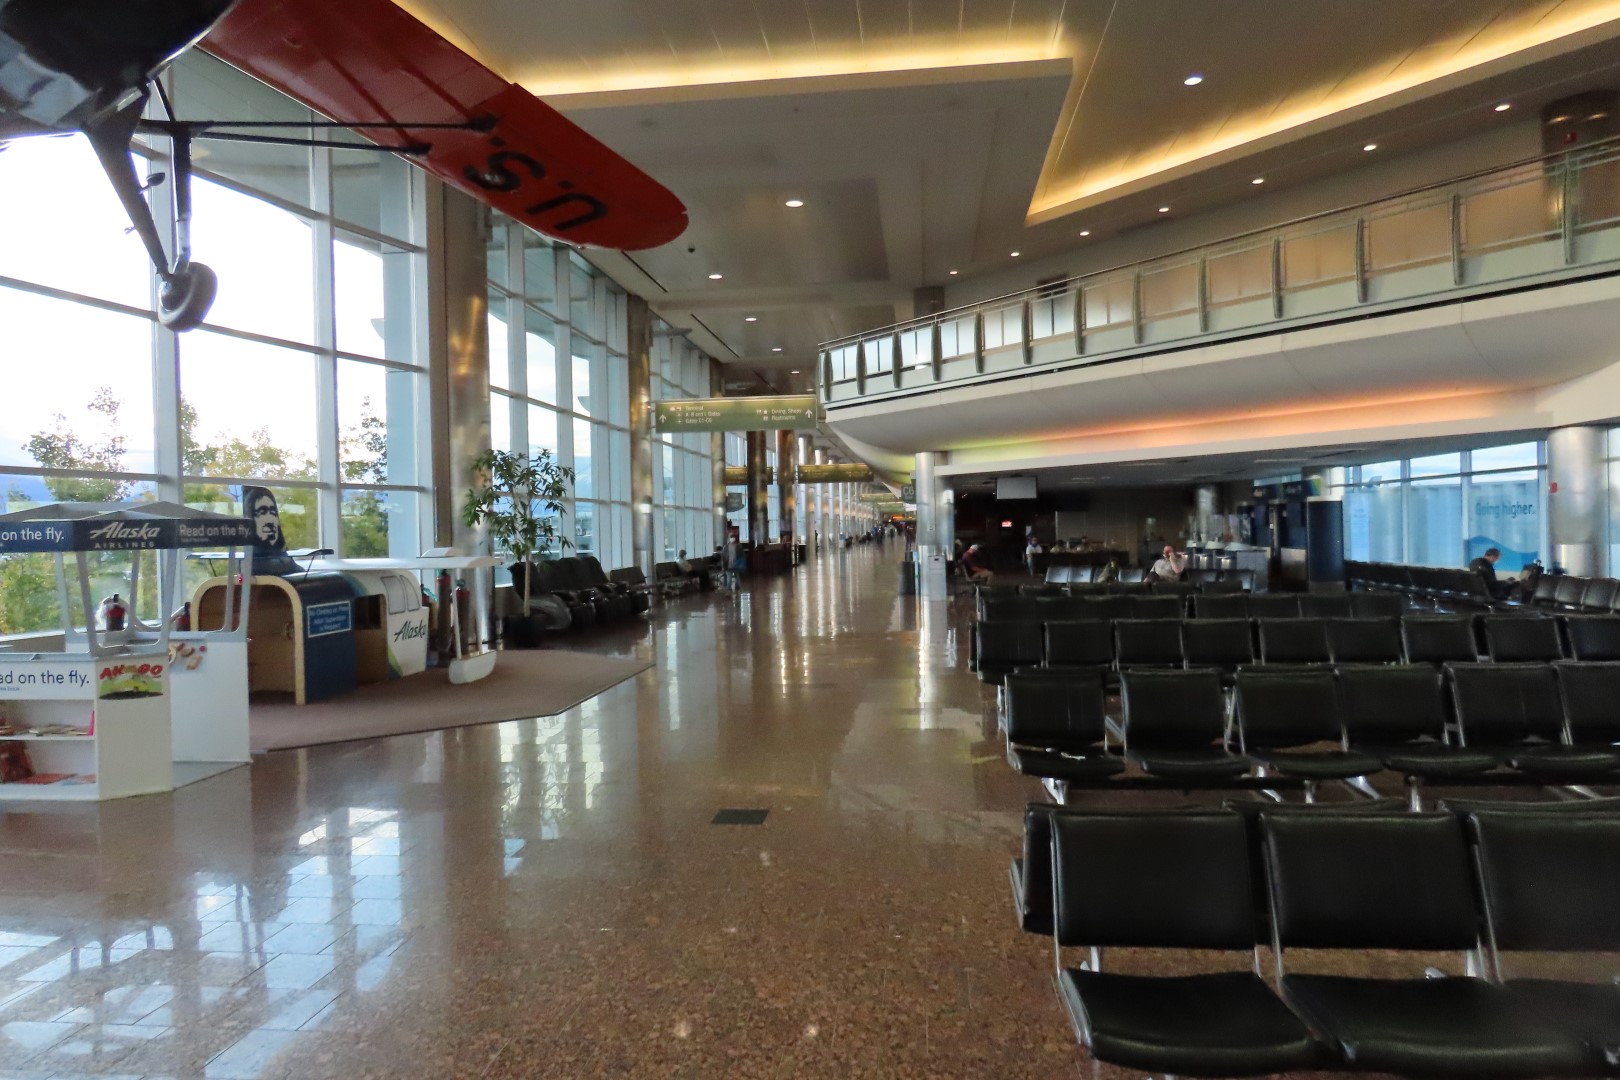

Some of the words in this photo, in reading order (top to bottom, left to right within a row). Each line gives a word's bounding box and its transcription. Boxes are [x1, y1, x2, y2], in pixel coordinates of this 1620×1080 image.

[903, 486, 914, 495] C6
[1475, 502, 1500, 519] Going
[1, 530, 18, 541] on
[21, 528, 42, 541] the
[45, 528, 65, 543] fly.
[90, 521, 161, 540] Alaska
[179, 524, 204, 537] Read
[207, 527, 219, 536] on
[220, 525, 236, 536] the
[94, 541, 156, 549] AIRLINES
[394, 620, 427, 642] Alaska
[18, 674, 36, 684] on
[41, 670, 64, 684] the
[69, 670, 90, 687] fly.
